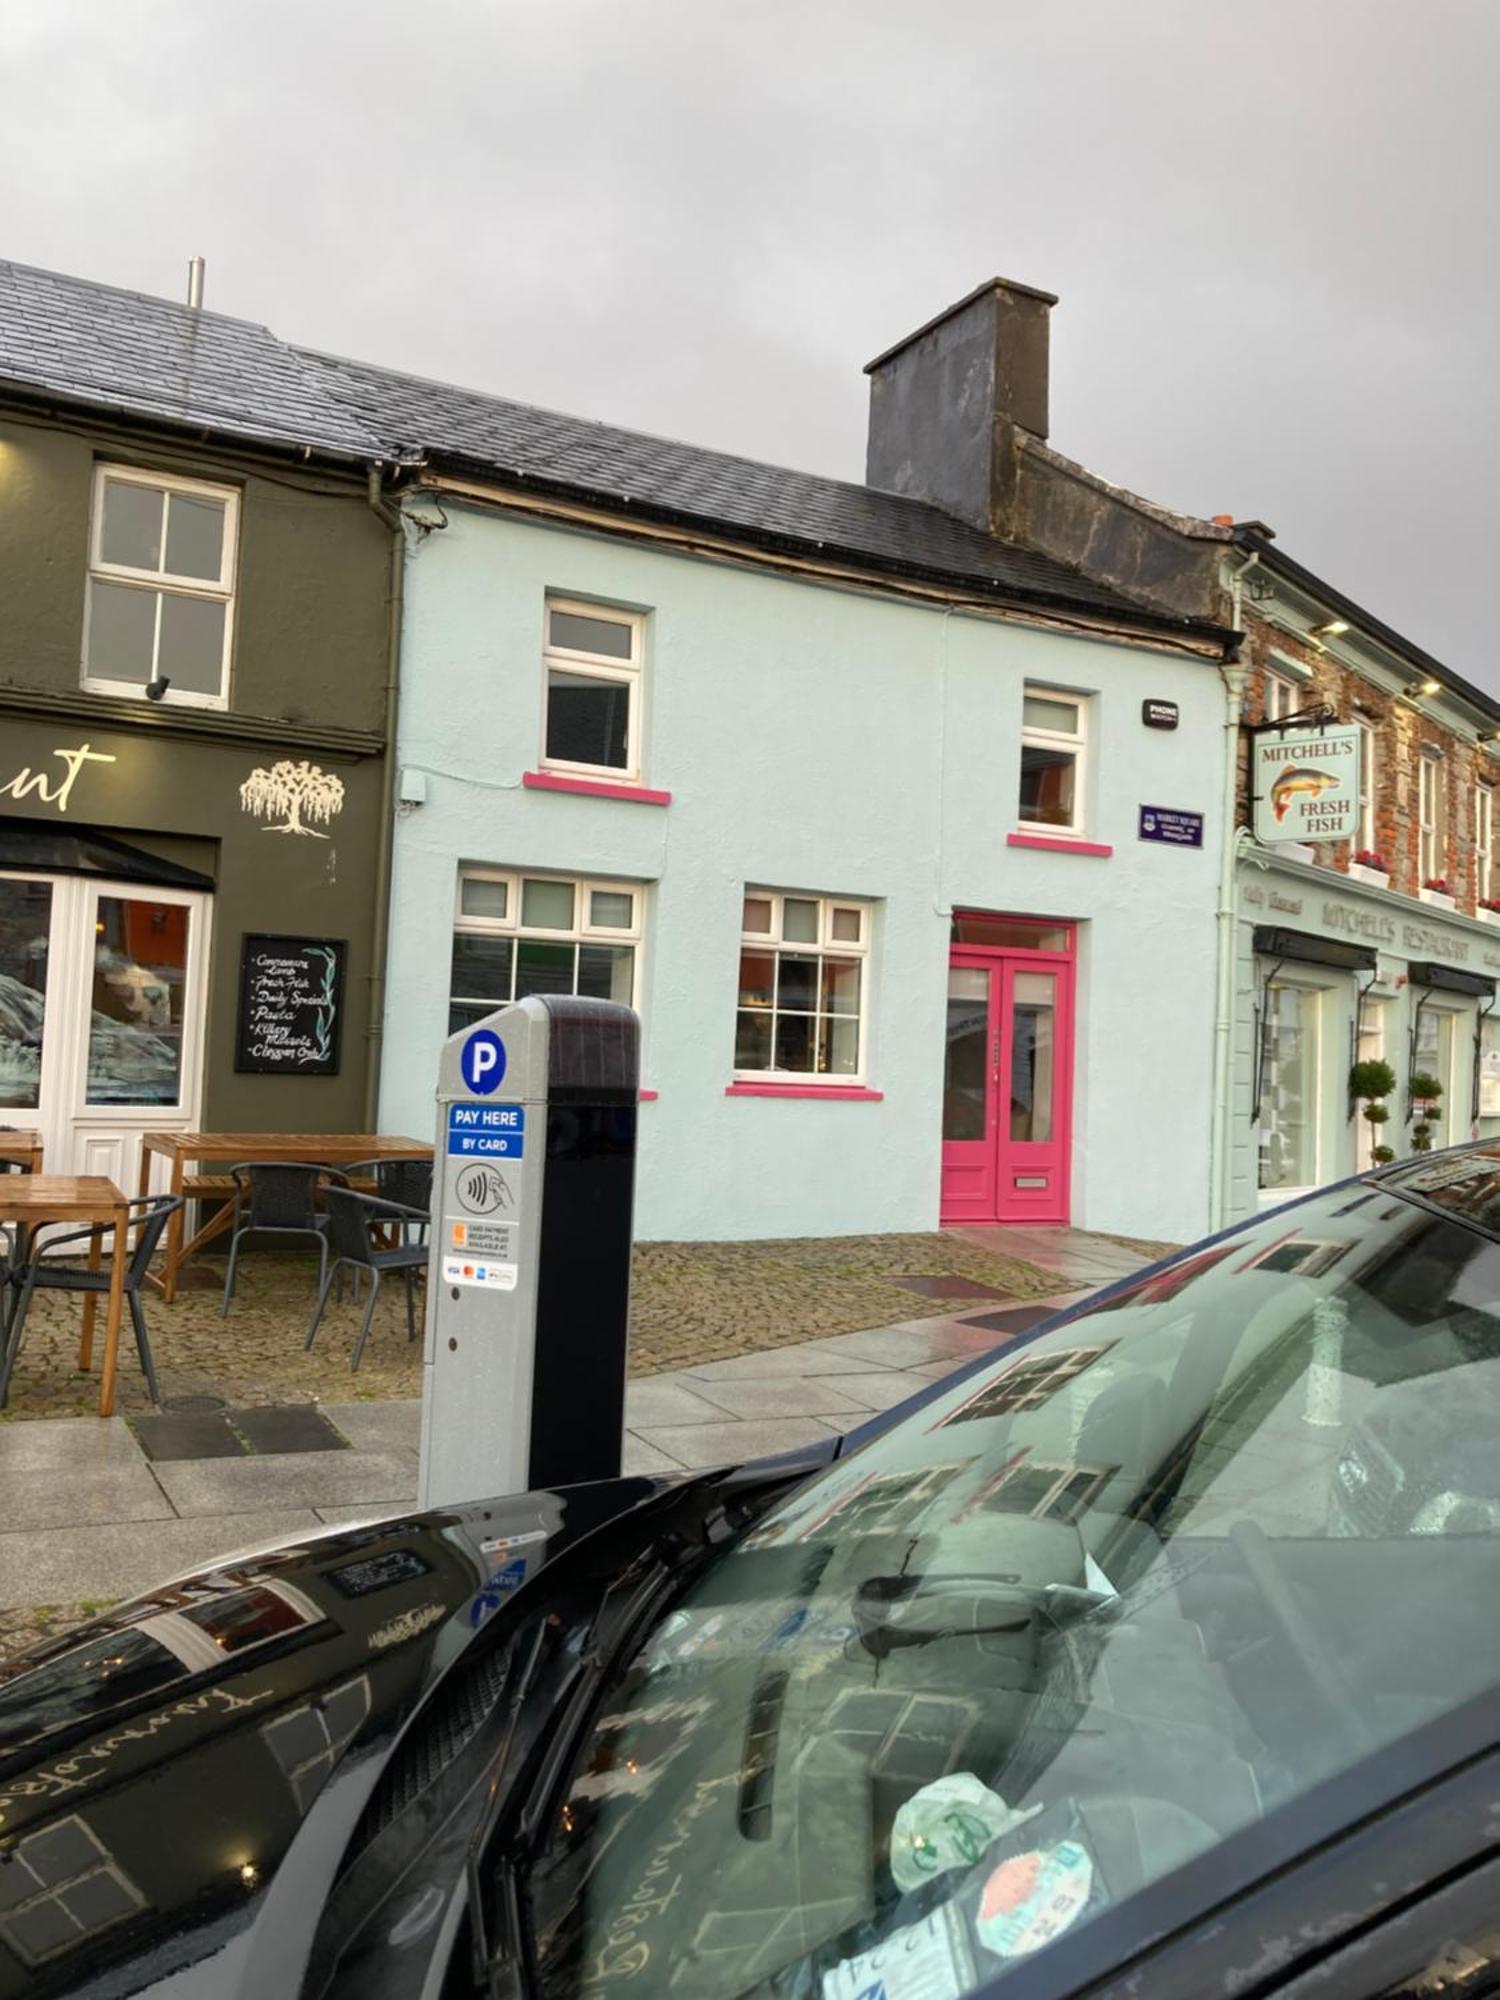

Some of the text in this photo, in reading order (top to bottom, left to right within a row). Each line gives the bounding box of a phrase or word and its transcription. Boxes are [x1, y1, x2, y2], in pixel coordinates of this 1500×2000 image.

[1150, 704, 1177, 716] PHONE
[1262, 741, 1353, 762] MITCHELL'S
[1300, 800, 1350, 817] FRESH
[1307, 818, 1343, 833] FISH
[257, 990, 288, 1009] Daily
[473, 1042, 497, 1083] P
[455, 1110, 518, 1126] PAY HERE
[462, 1138, 507, 1151] BY CARD
